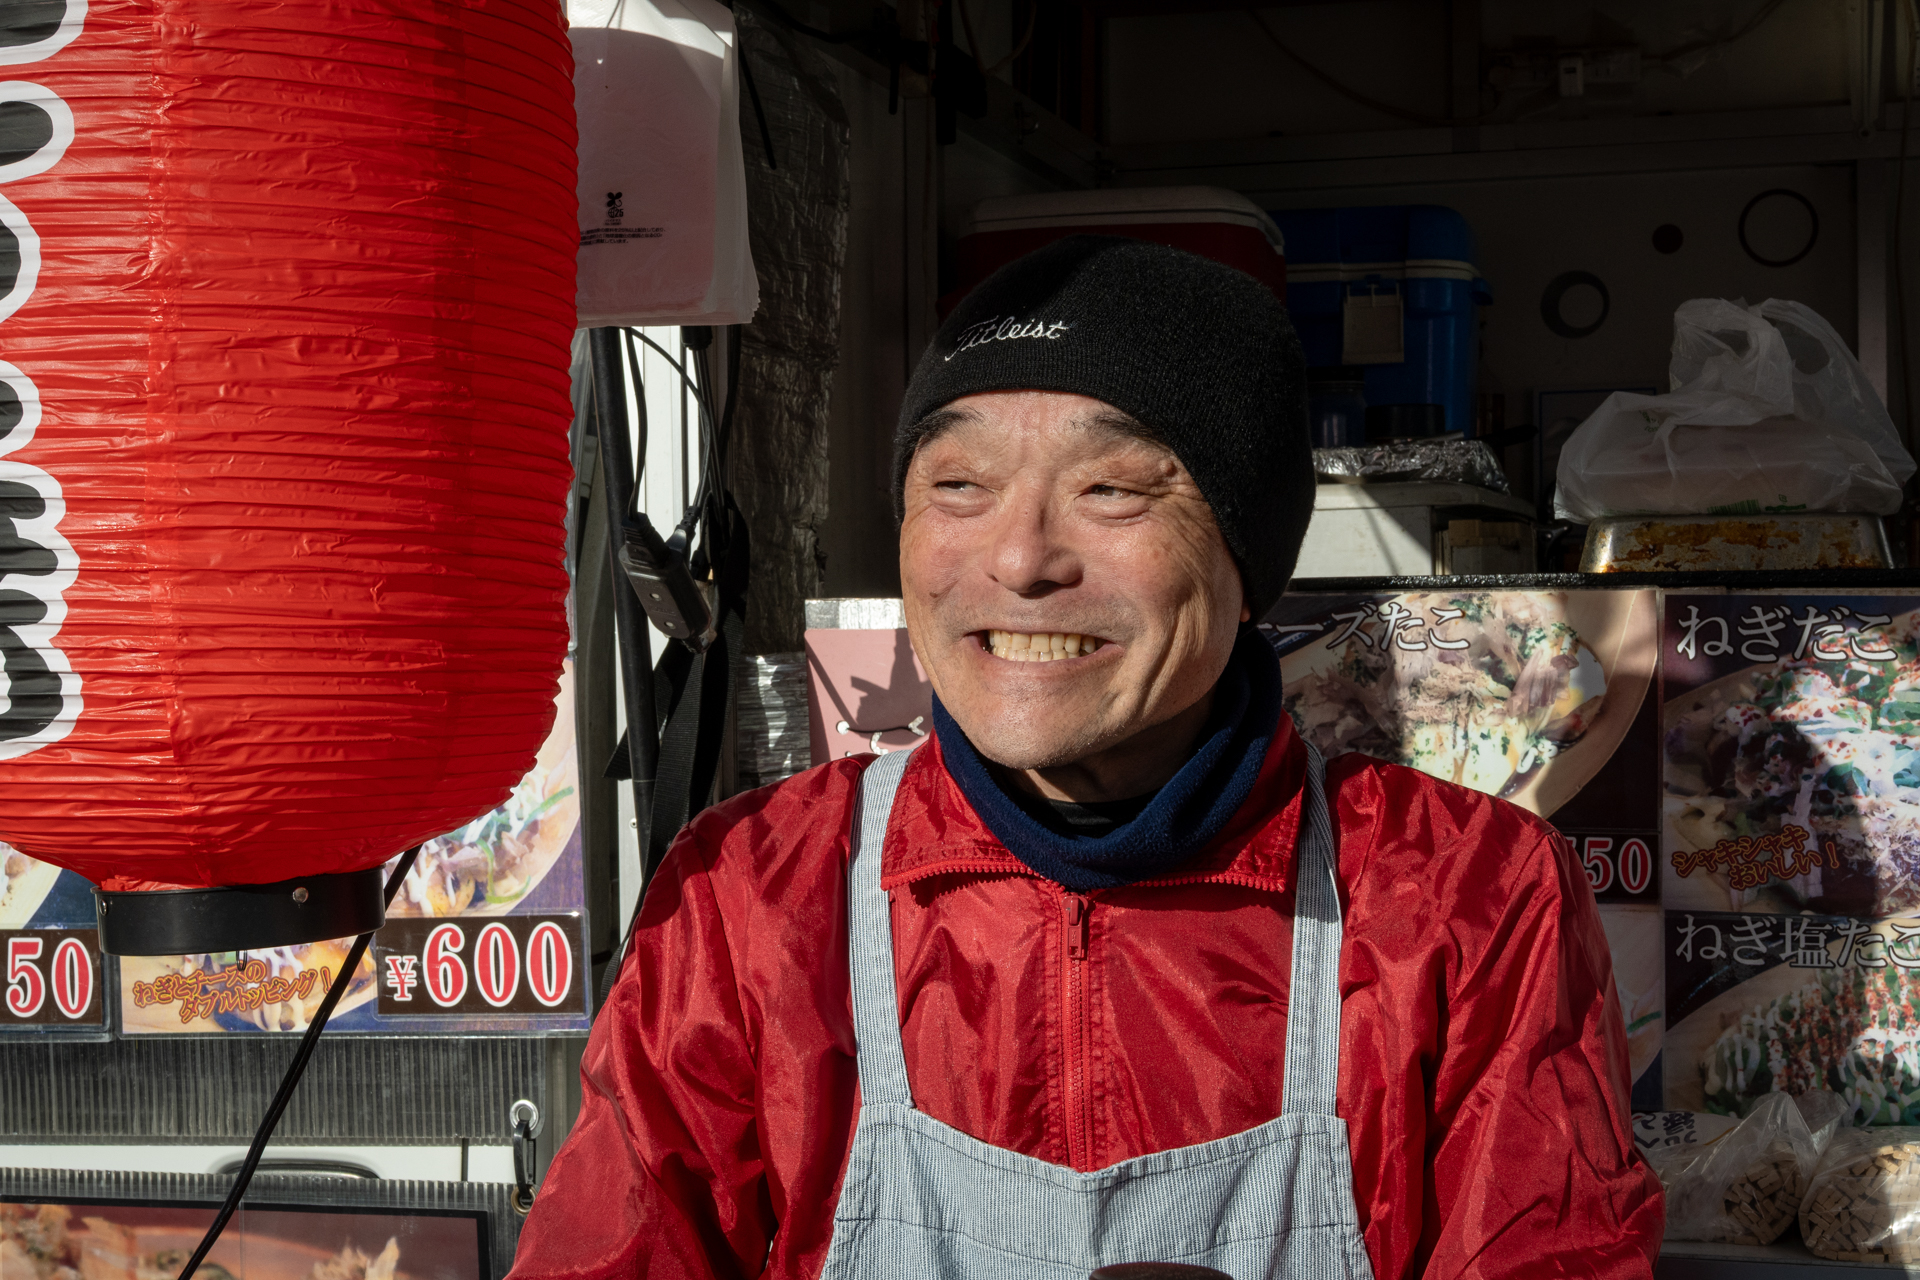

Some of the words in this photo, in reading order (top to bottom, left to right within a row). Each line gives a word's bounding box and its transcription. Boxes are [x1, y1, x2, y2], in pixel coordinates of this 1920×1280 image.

[945, 315, 1070, 361] Titleist
[1258, 602, 1470, 650] ーズたこ
[1676, 605, 1898, 662] ねぎだこ
[1566, 836, 1652, 894] 50
[1672, 824, 1809, 878] シャキシャキ
[1675, 914, 1920, 968] ねぎ塩たこ
[6, 937, 93, 1019] 50
